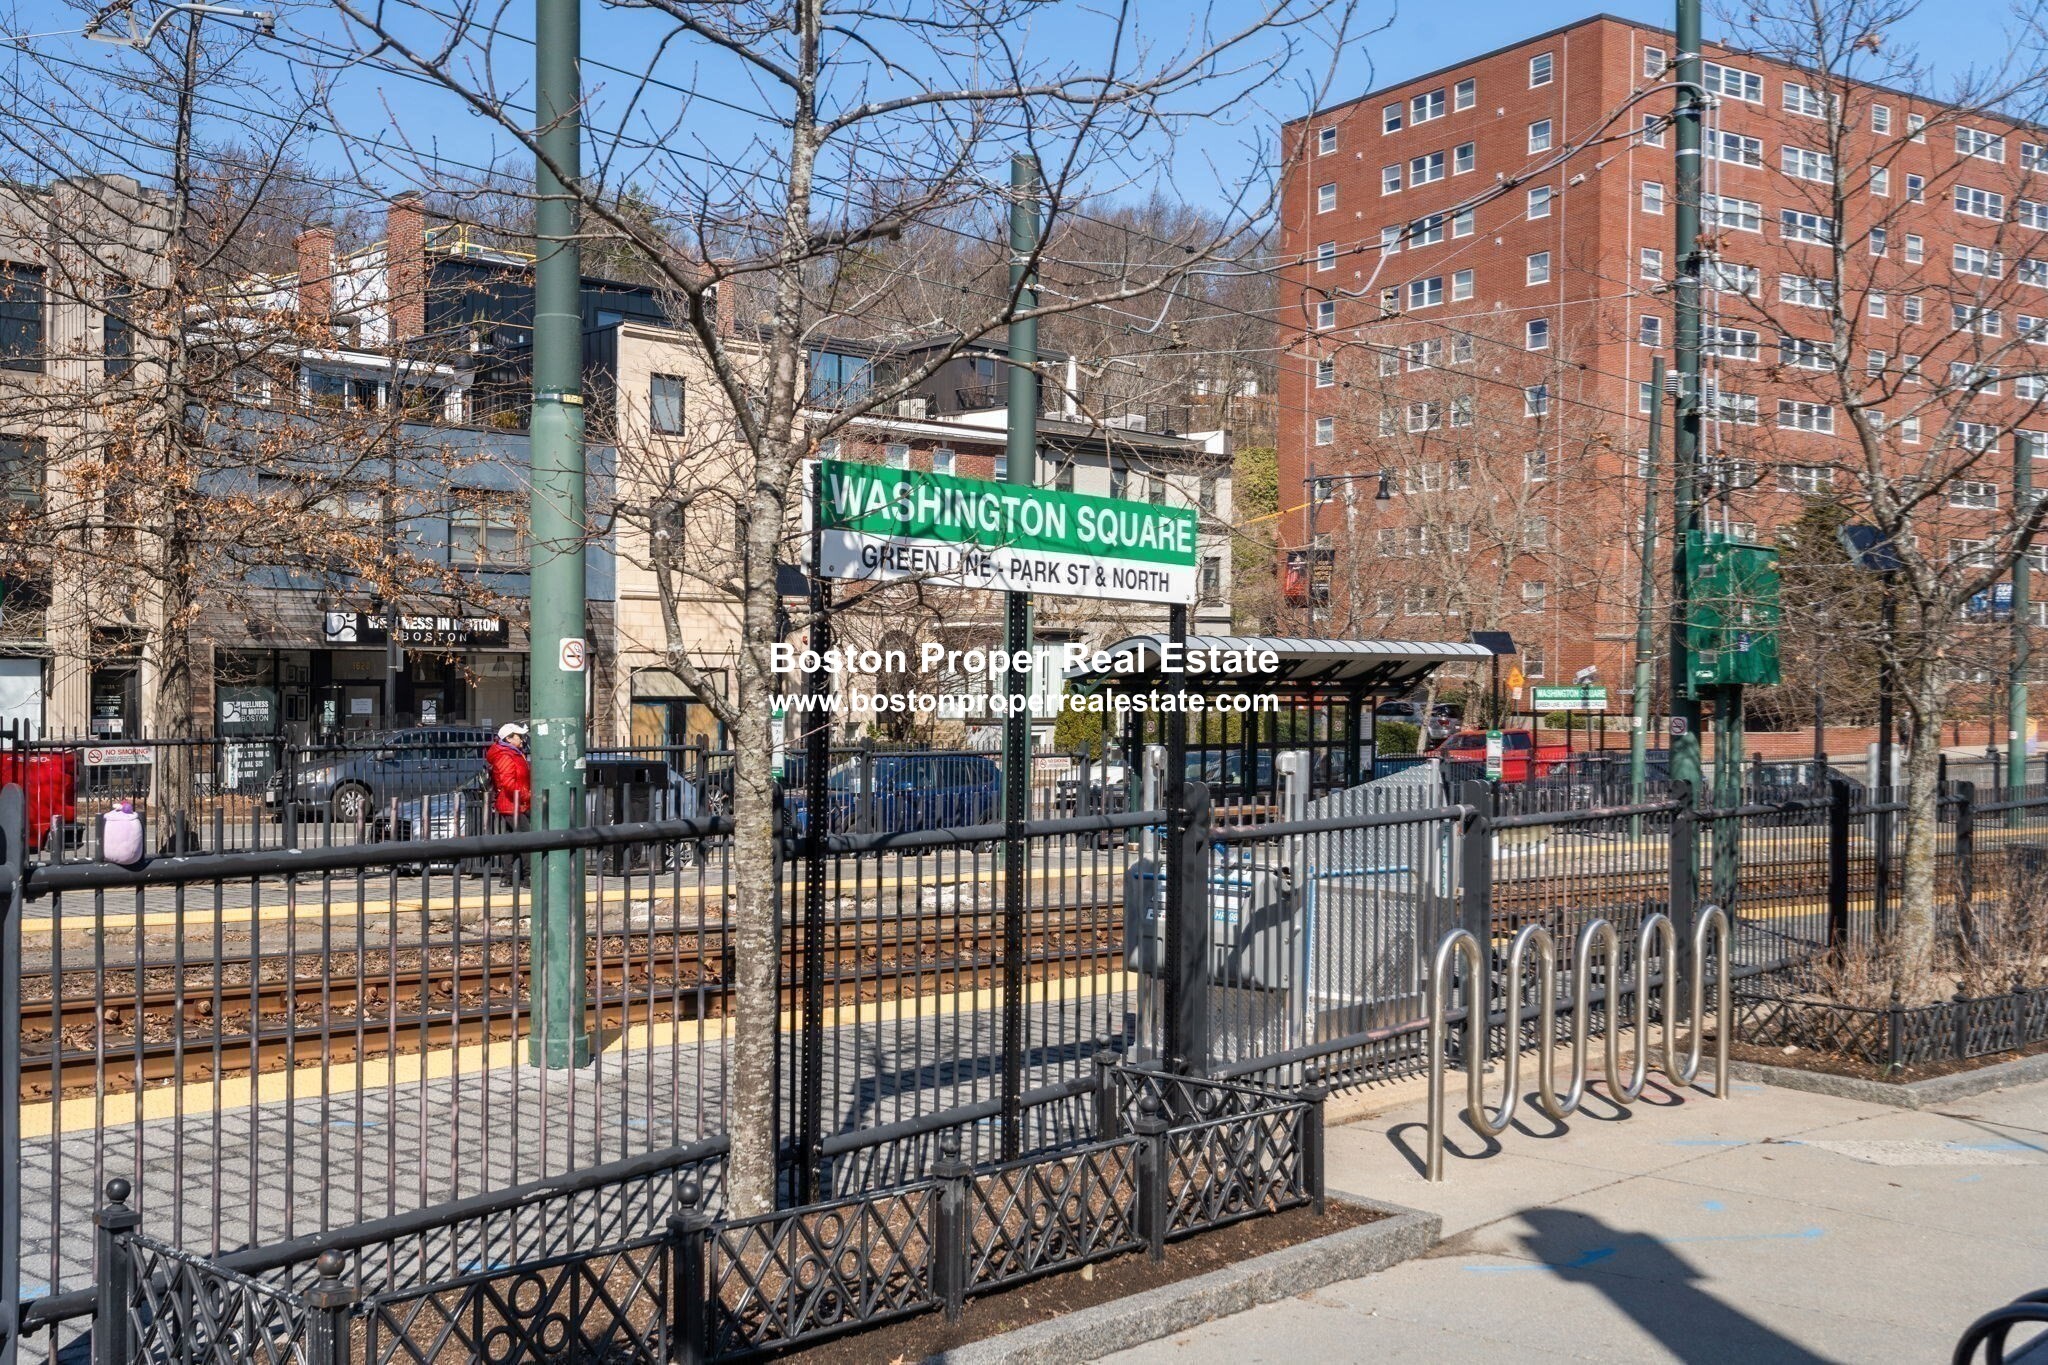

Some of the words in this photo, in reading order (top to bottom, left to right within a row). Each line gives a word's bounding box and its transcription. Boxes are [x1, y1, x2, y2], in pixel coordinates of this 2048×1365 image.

[830, 473, 1067, 539] WASHINGTON
[1077, 505, 1192, 552] SQUARE
[862, 544, 939, 574] GREEN
[947, 550, 991, 577] LINE
[1010, 558, 1060, 584] PARK
[1067, 563, 1090, 586] ST
[1095, 566, 1106, 588] &
[1113, 567, 1170, 593] NORTH
[367, 615, 434, 630] WELNESS
[437, 617, 450, 631] IN
[453, 618, 500, 632] MTION
[402, 631, 467, 642] BOSTON
[1536, 688, 1579, 698] WASHINGTON
[1580, 689, 1605, 698] SUARE
